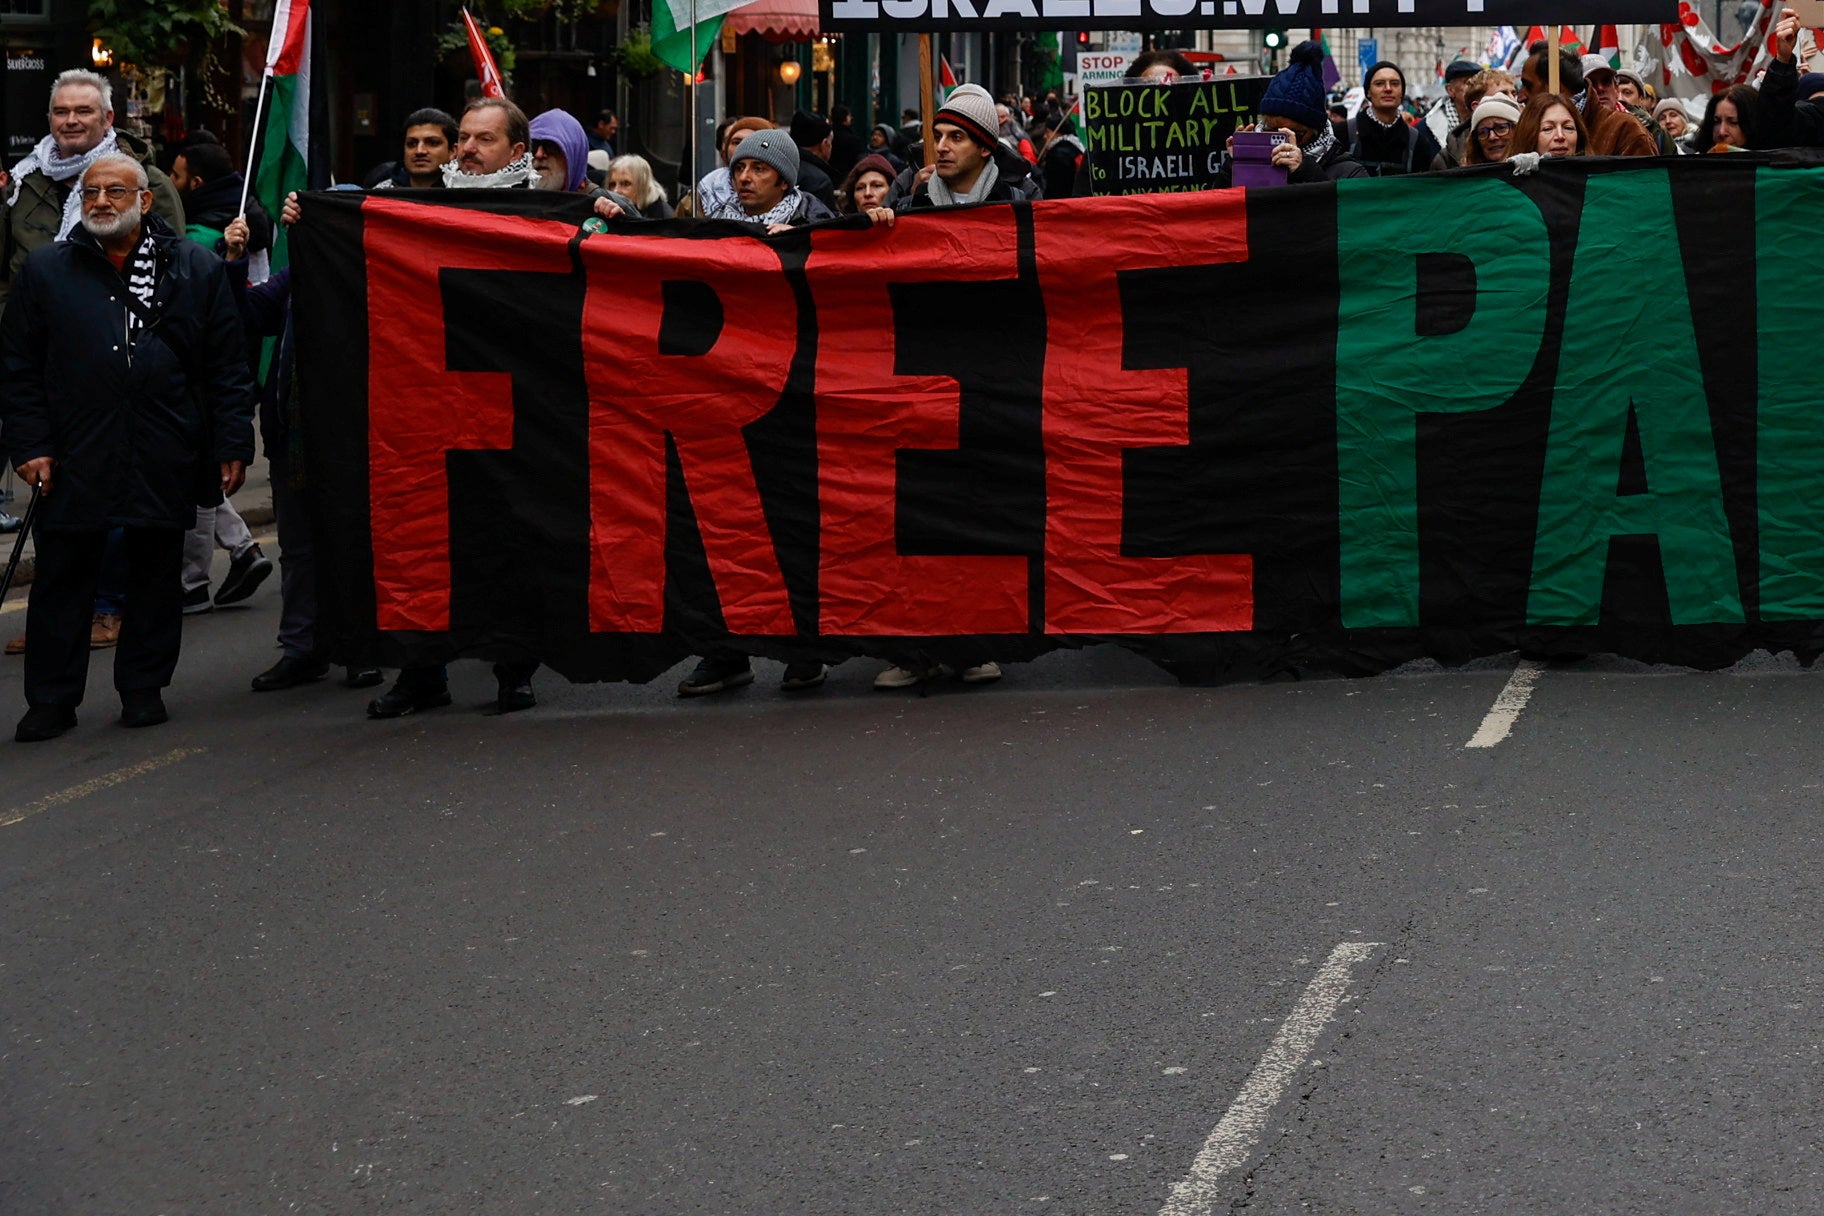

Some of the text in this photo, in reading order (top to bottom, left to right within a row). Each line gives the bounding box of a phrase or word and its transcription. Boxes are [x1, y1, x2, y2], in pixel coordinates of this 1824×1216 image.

[1082, 56, 1124, 70] STOP
[1082, 70, 1125, 80] ARMING
[1087, 83, 1249, 119] BLOCK ALL
[1087, 117, 1218, 152] MILITARY
[1091, 163, 1106, 181] to
[1118, 154, 1194, 180] ISRAELI
[361, 185, 1254, 636] FREE
